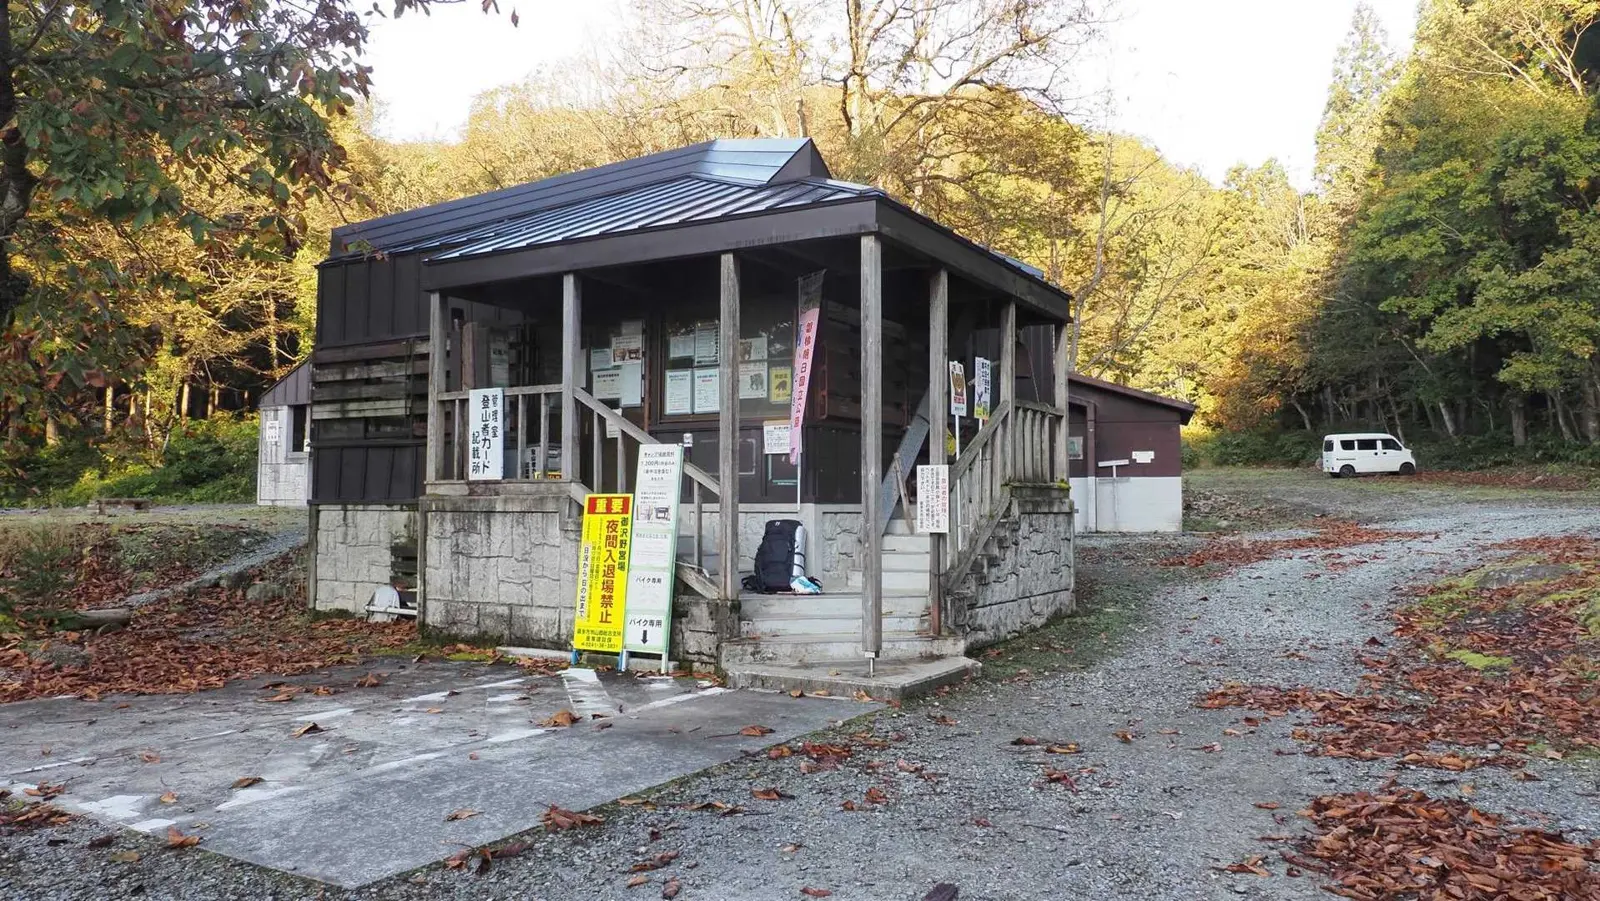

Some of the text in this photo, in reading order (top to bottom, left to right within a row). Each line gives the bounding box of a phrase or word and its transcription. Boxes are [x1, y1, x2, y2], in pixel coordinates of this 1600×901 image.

[481, 394, 491, 474] 登山者カード
[491, 394, 499, 438] 管理室
[472, 431, 480, 474] 記載所
[594, 498, 624, 513] 重要
[617, 517, 629, 572] 御沢野営場
[599, 519, 620, 624] 夜間入退場禁止
[635, 575, 662, 584] バイク専用
[629, 618, 663, 628] バイク専用
